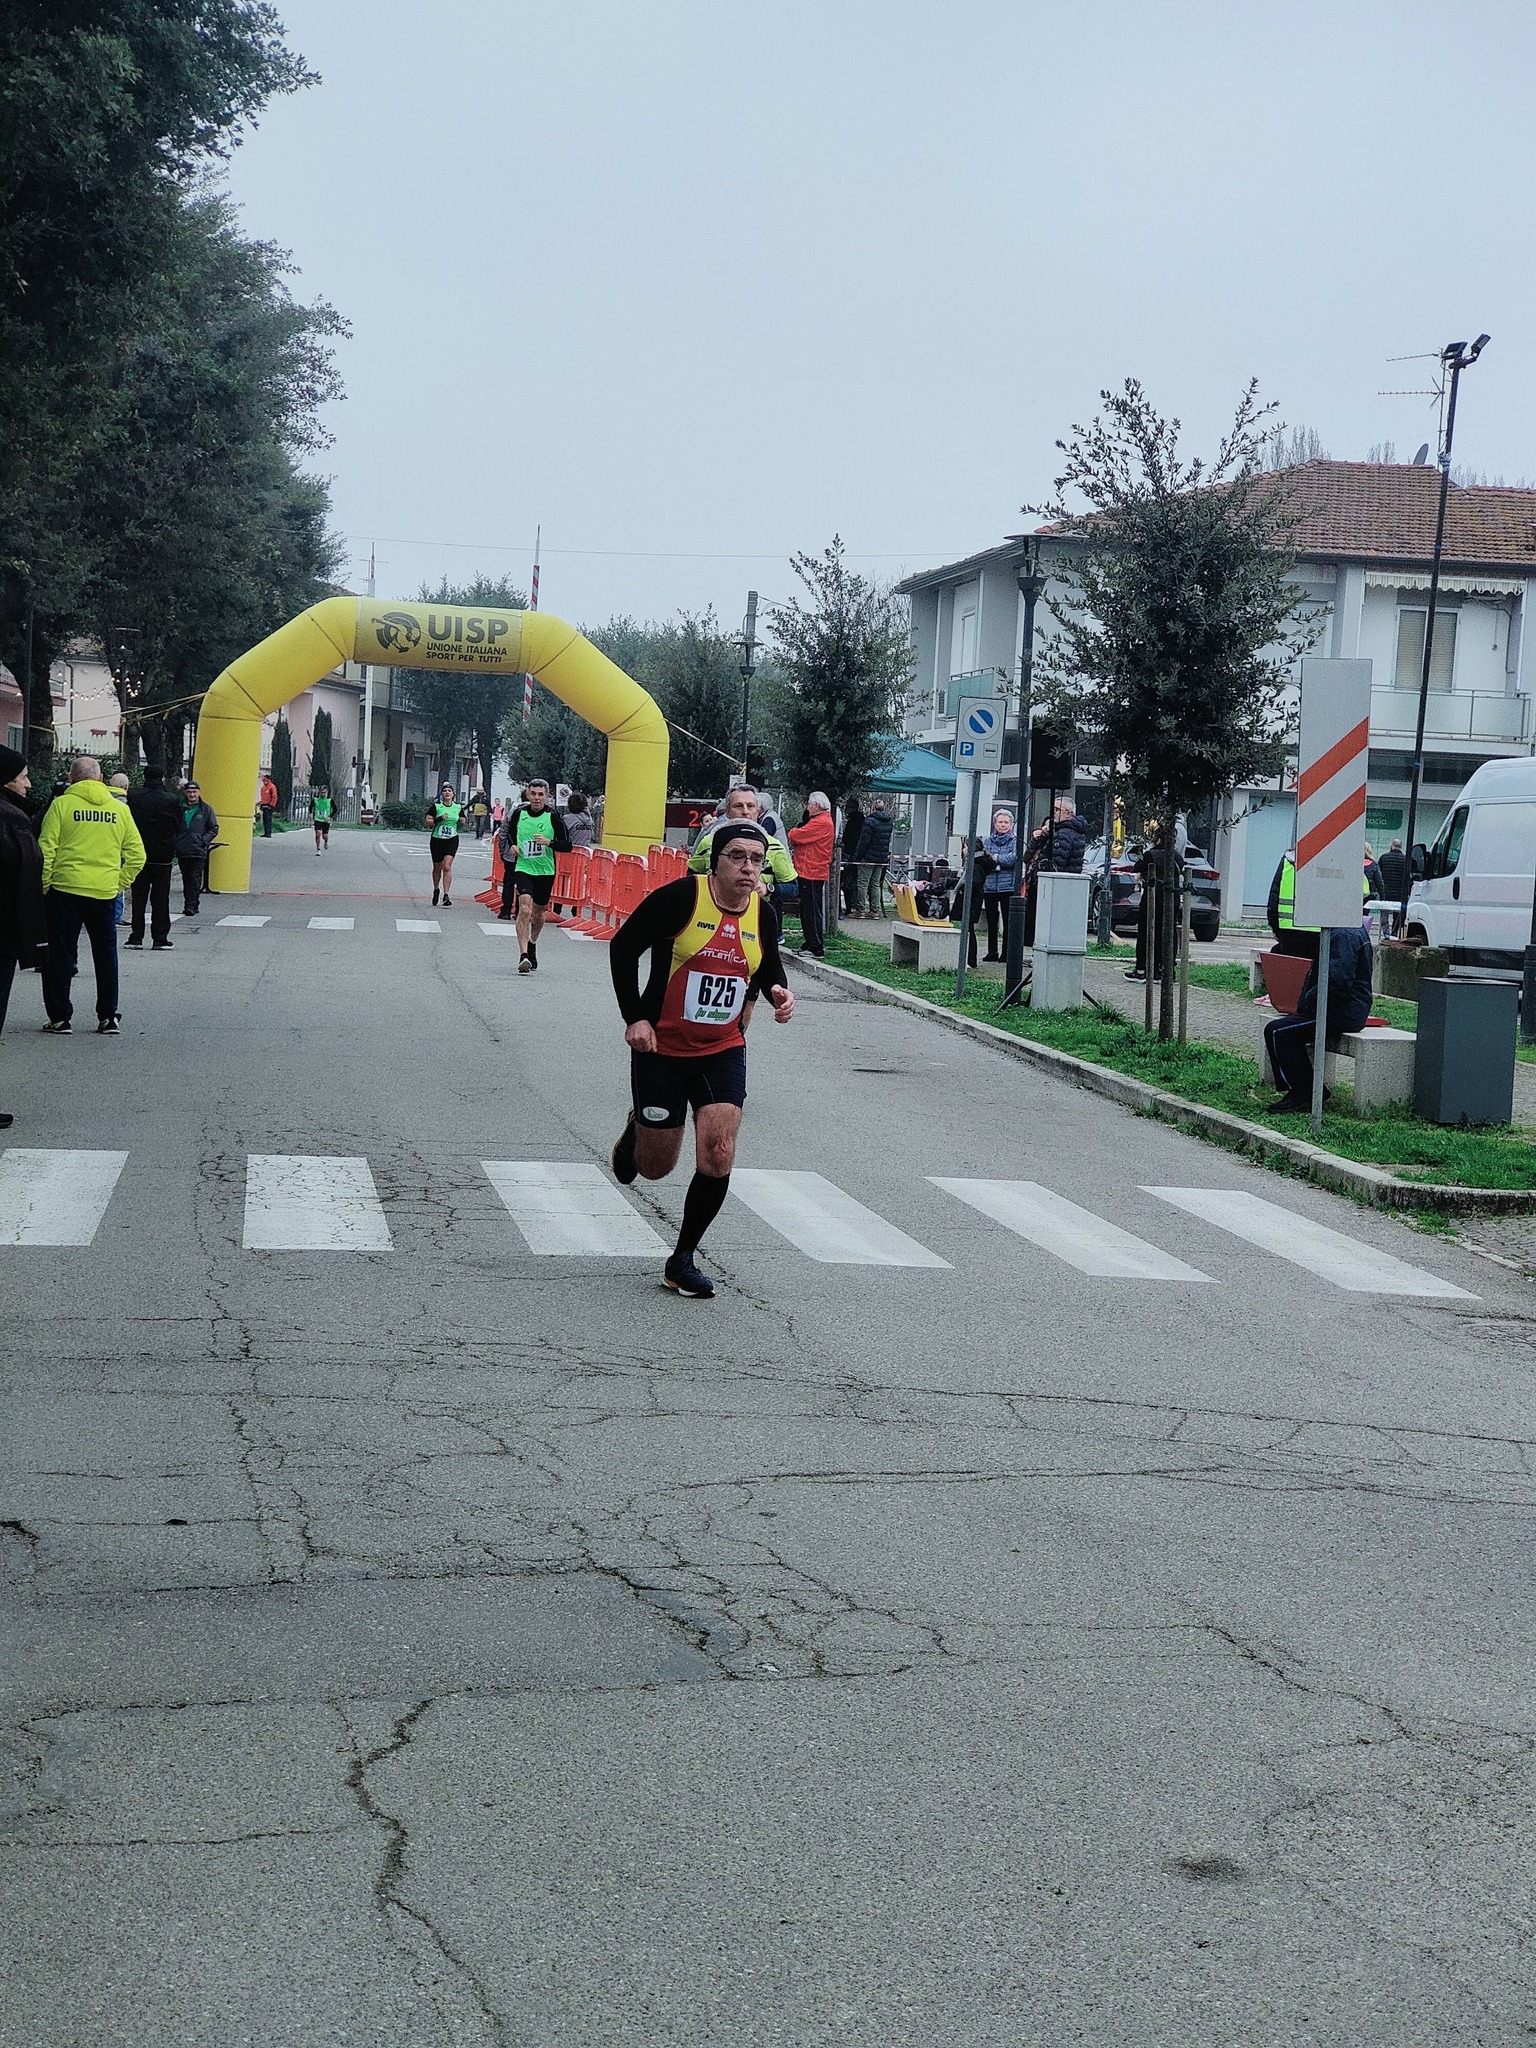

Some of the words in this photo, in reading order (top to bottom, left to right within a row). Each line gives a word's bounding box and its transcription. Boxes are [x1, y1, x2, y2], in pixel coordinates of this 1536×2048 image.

[428, 614, 509, 645] UISP
[427, 642, 463, 653] UNIONE
[466, 645, 508, 656] ITALIANA
[426, 651, 454, 661] SPORT
[458, 654, 474, 663] PER
[479, 655, 502, 664] TUTTI
[73, 810, 117, 824] GIUDICE
[696, 921, 716, 931] AVIS
[698, 975, 738, 1008] 625
